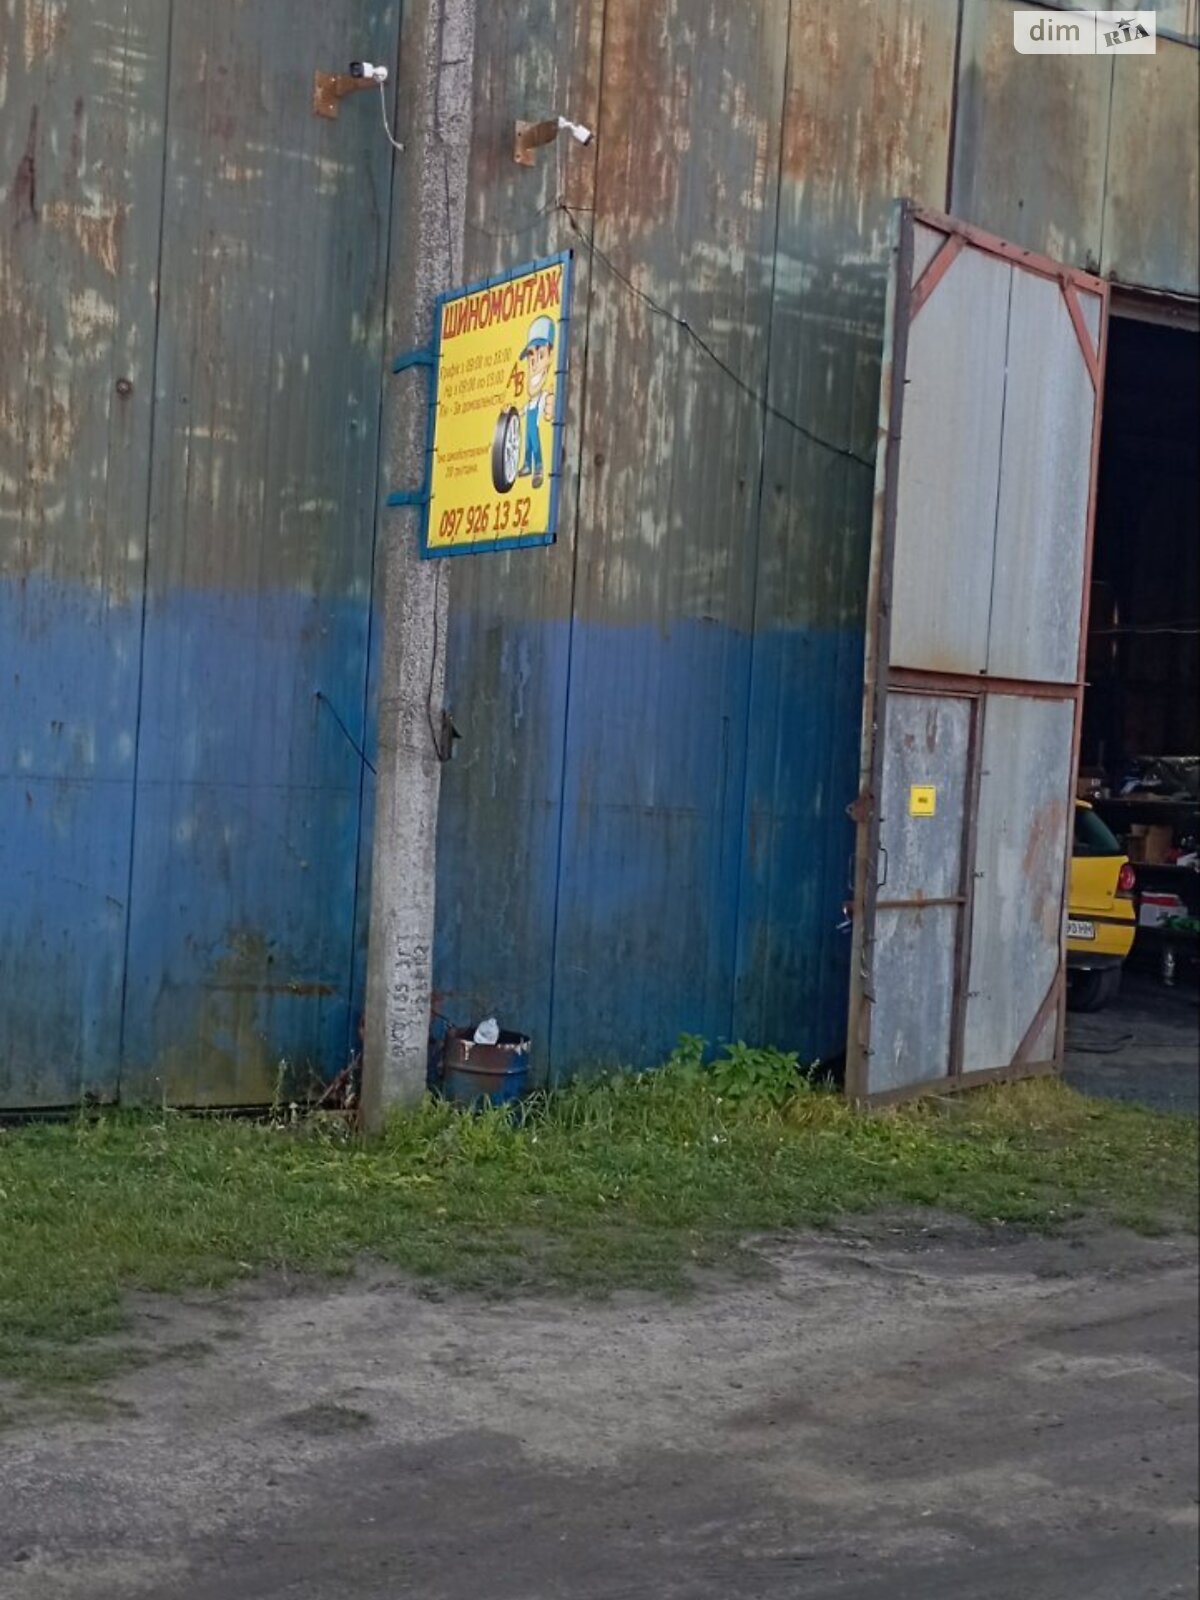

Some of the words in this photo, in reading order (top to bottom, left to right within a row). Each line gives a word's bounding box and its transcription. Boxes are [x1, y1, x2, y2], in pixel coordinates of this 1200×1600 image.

[443, 265, 562, 339] ШИНОМОНТАЖ
[440, 508, 464, 537] 097
[466, 504, 490, 533] 926
[493, 501, 510, 530] 13
[512, 497, 531, 527] 52
